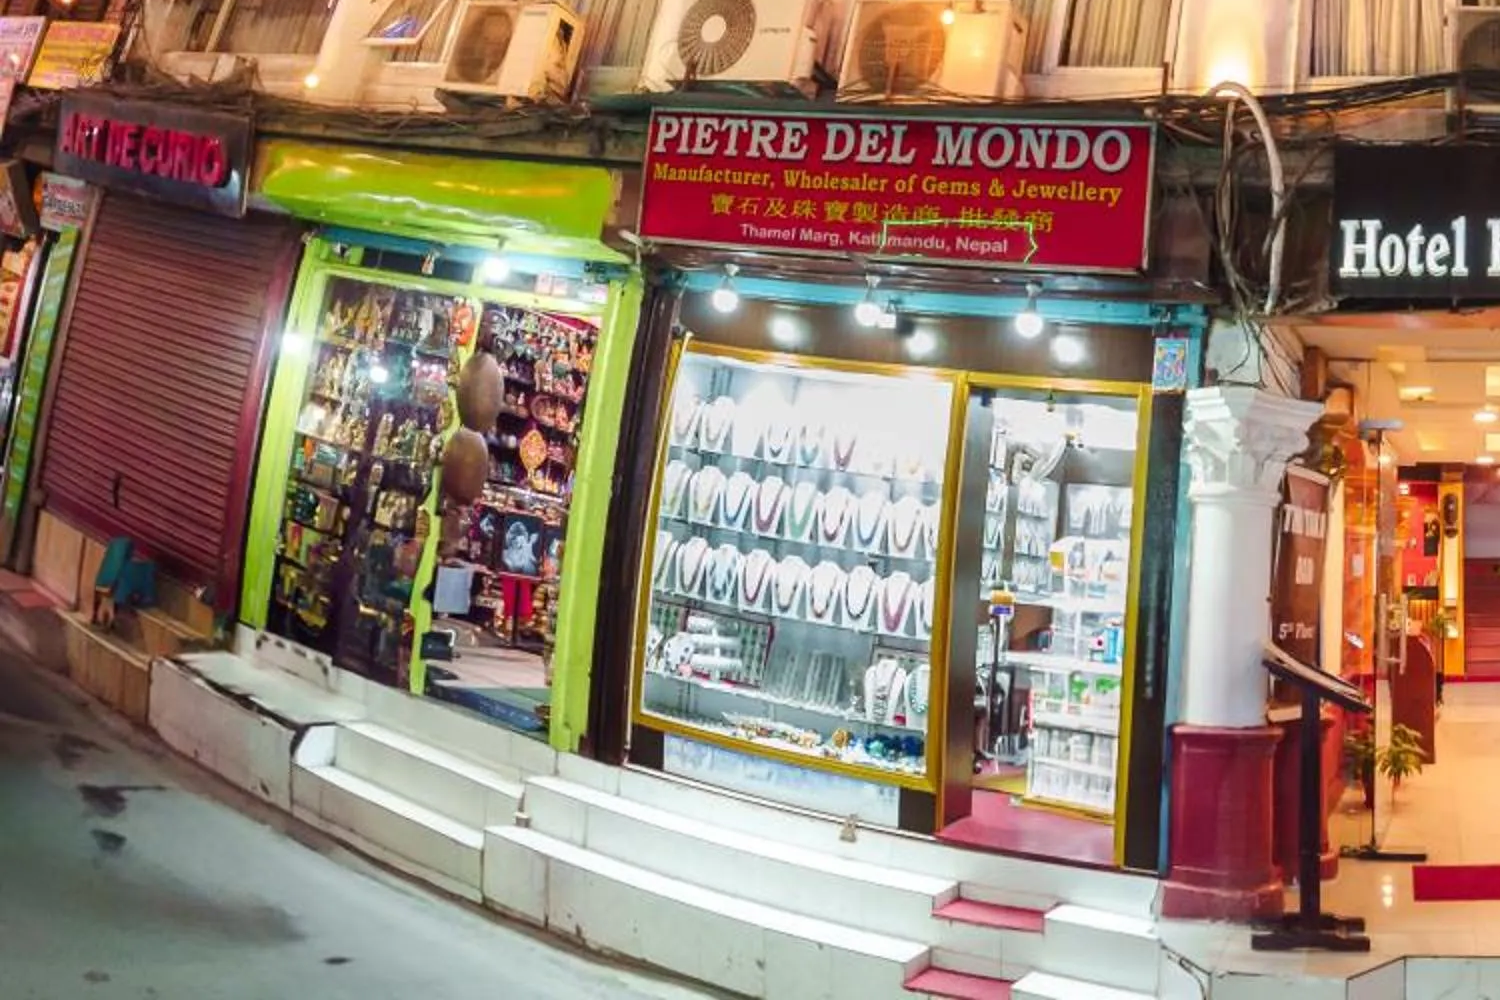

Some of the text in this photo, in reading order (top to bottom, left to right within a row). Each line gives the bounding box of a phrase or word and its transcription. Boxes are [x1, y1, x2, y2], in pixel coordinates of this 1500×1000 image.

[61, 112, 106, 160] ART
[139, 122, 226, 187] CURIO
[652, 115, 1132, 173] PIETRE DEL MONDO
[653, 162, 1122, 207] Manufacturer, Wholesaler of Gems & Jewellery
[740, 223, 797, 241] Thamel
[955, 236, 1009, 255] Nepal
[1339, 215, 1469, 279] Hotel
